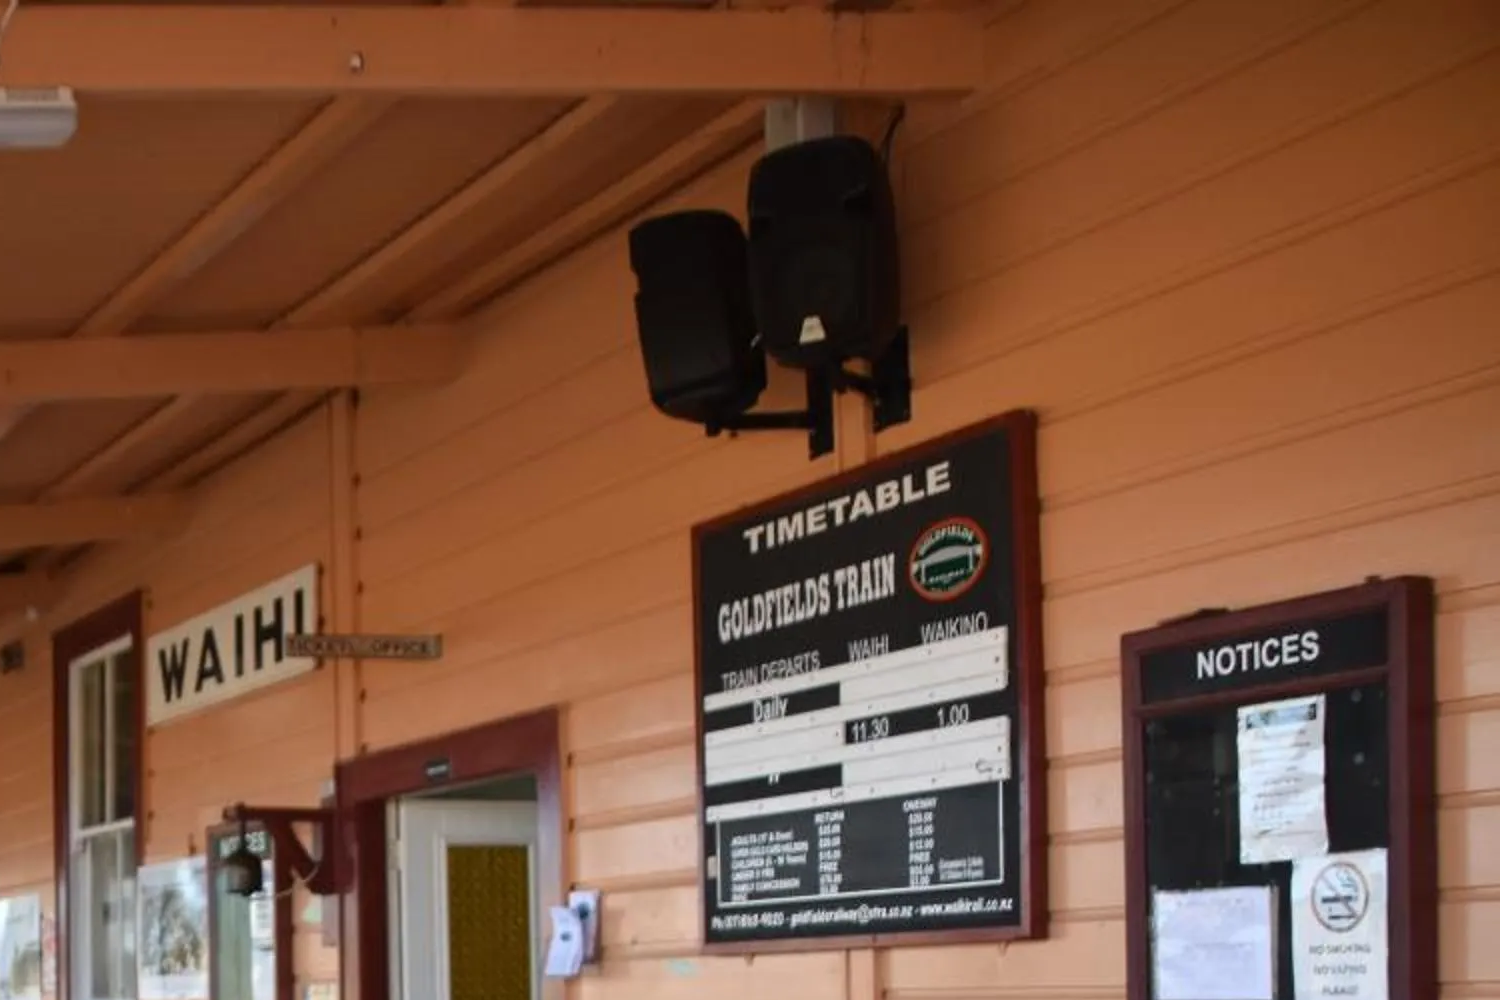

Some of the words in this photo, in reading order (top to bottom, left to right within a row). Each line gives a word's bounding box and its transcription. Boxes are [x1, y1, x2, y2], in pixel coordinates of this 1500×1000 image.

[743, 461, 951, 554] TIMETABLE
[717, 570, 831, 644] GOLDFIELDS
[833, 552, 896, 611] TRAIN
[158, 587, 305, 703] WAIHI
[721, 666, 759, 692] TRAIN
[760, 650, 820, 682] DEPARTS
[848, 634, 889, 663] WAIHI
[921, 611, 989, 647] WAIKINO
[1197, 631, 1320, 680] NOTICES
[753, 694, 788, 723] Daily
[851, 717, 889, 743] 11.30
[937, 703, 969, 728] 1.00
